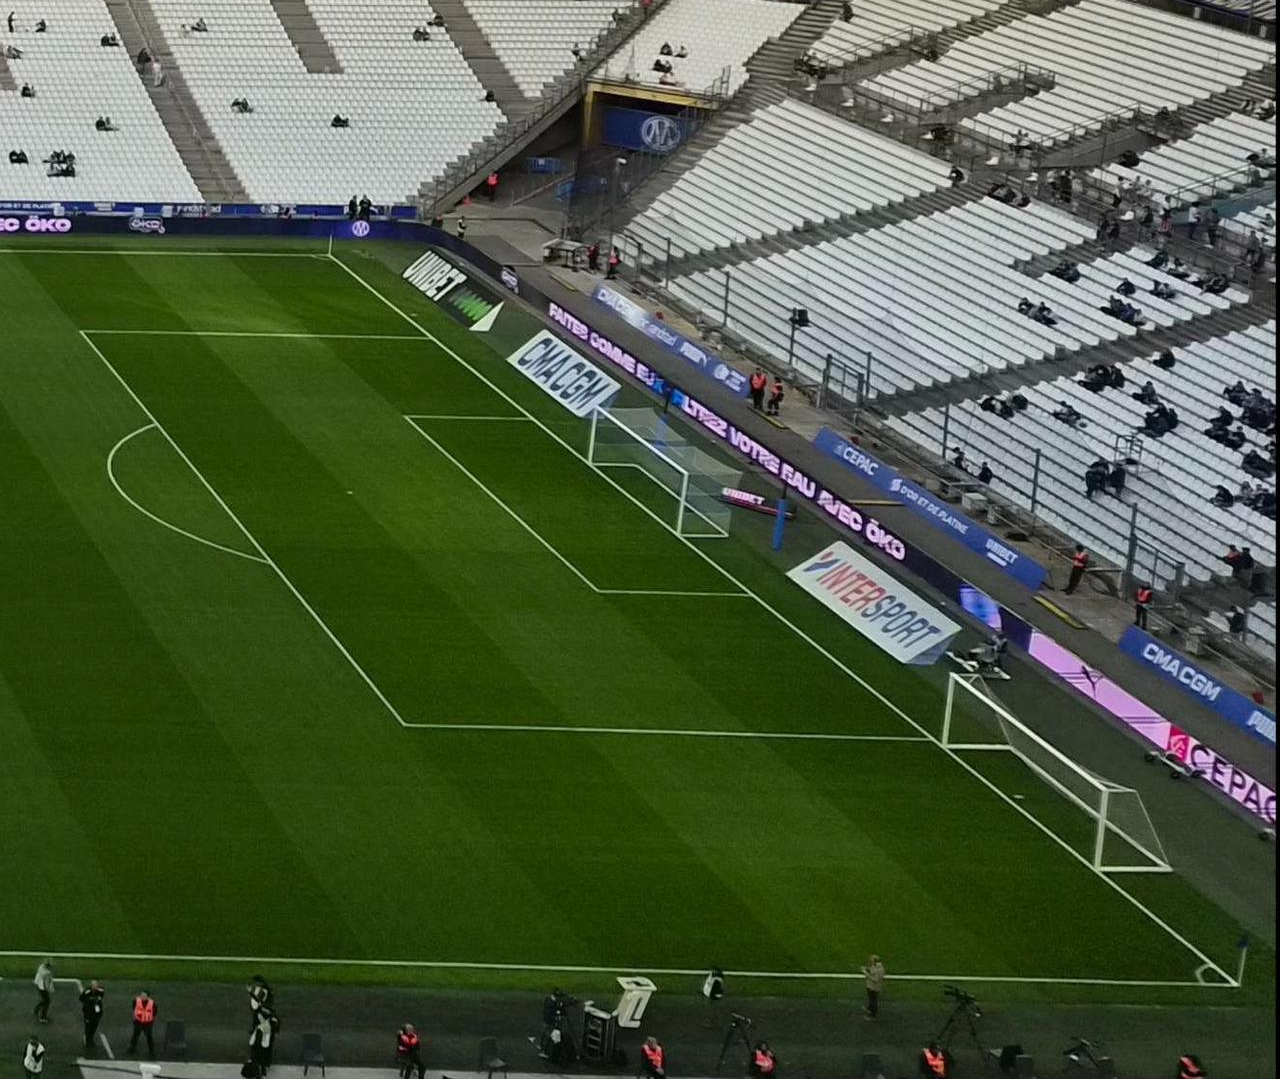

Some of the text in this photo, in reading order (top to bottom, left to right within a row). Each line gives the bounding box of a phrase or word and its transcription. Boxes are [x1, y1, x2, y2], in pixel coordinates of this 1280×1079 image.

[25, 214, 71, 232] ÖKO
[402, 250, 467, 302] UNIBET
[517, 337, 611, 410] CMA CGM
[549, 302, 589, 340] FAITES
[590, 332, 636, 374] COMME
[729, 426, 780, 475] VOTRE
[780, 464, 817, 499] EAU
[817, 490, 863, 532] AVEC
[865, 519, 907, 562] ÖKO
[842, 446, 879, 476] CEPAC
[985, 537, 1019, 565] UNIBET
[816, 561, 942, 648] INTERSPORT
[1143, 642, 1222, 701] CMA CGM
[1190, 743, 1277, 826] CEPAC
